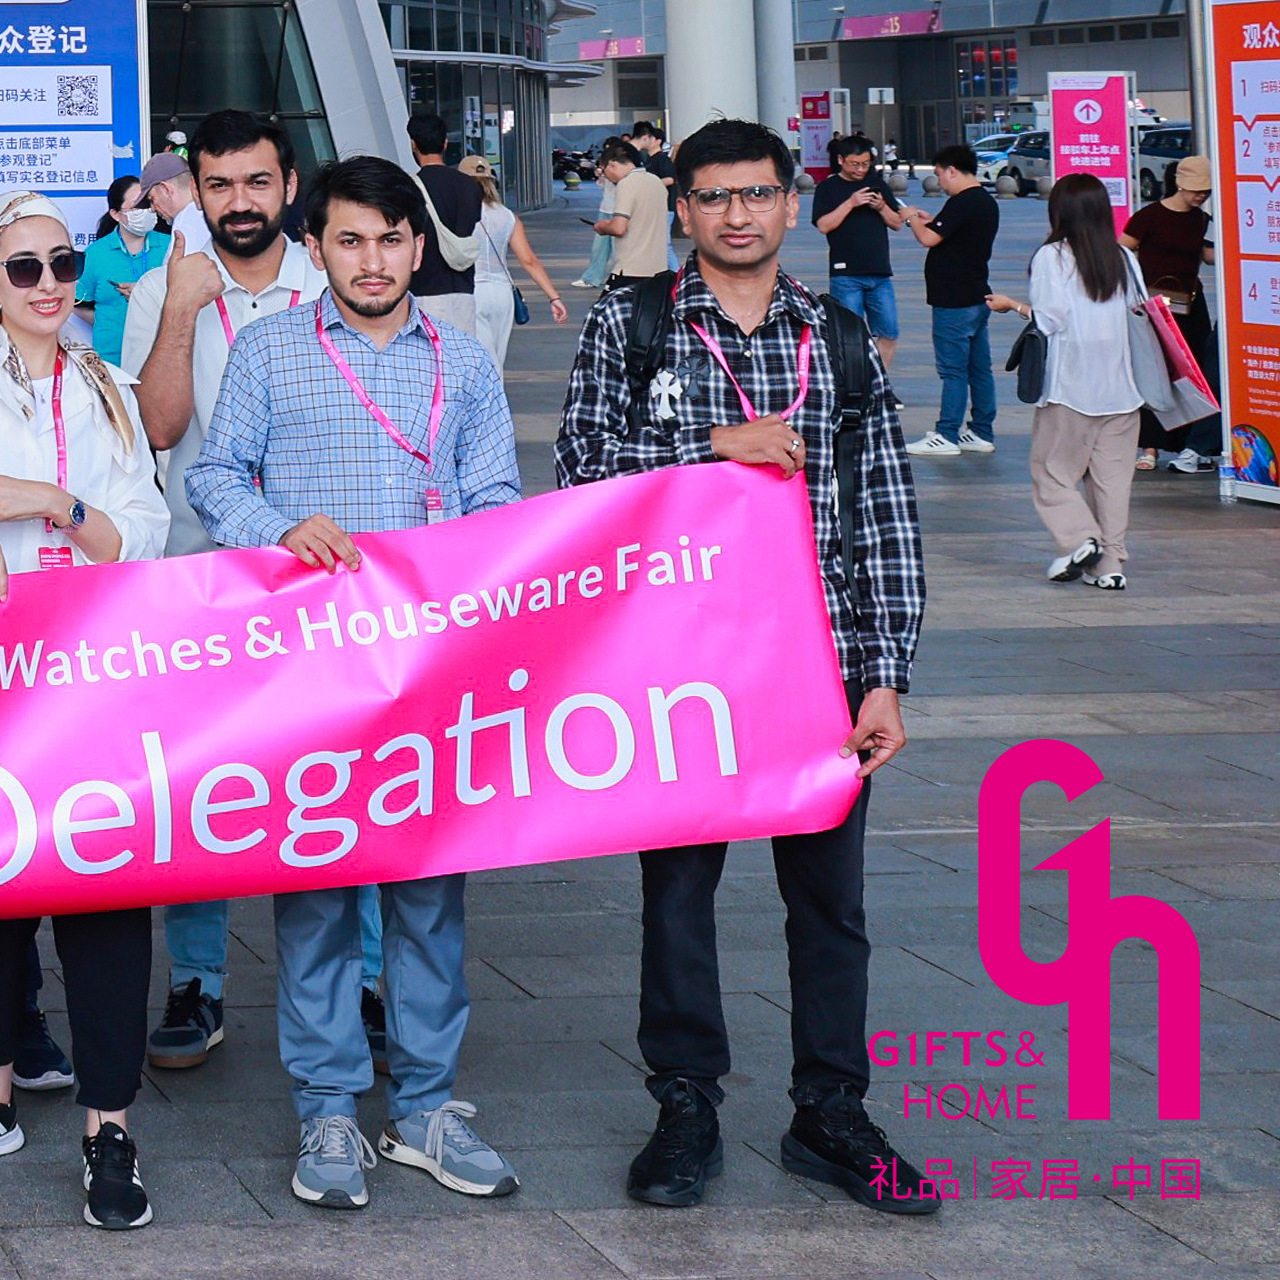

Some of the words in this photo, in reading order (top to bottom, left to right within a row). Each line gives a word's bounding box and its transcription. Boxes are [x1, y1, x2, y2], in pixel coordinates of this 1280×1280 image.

[1242, 139, 1251, 158] 2
[1245, 208, 1255, 228] 3
[1248, 282, 1258, 301] 4
[244, 616, 285, 661] &
[297, 567, 604, 652] Houseware
[616, 534, 723, 591] Fair
